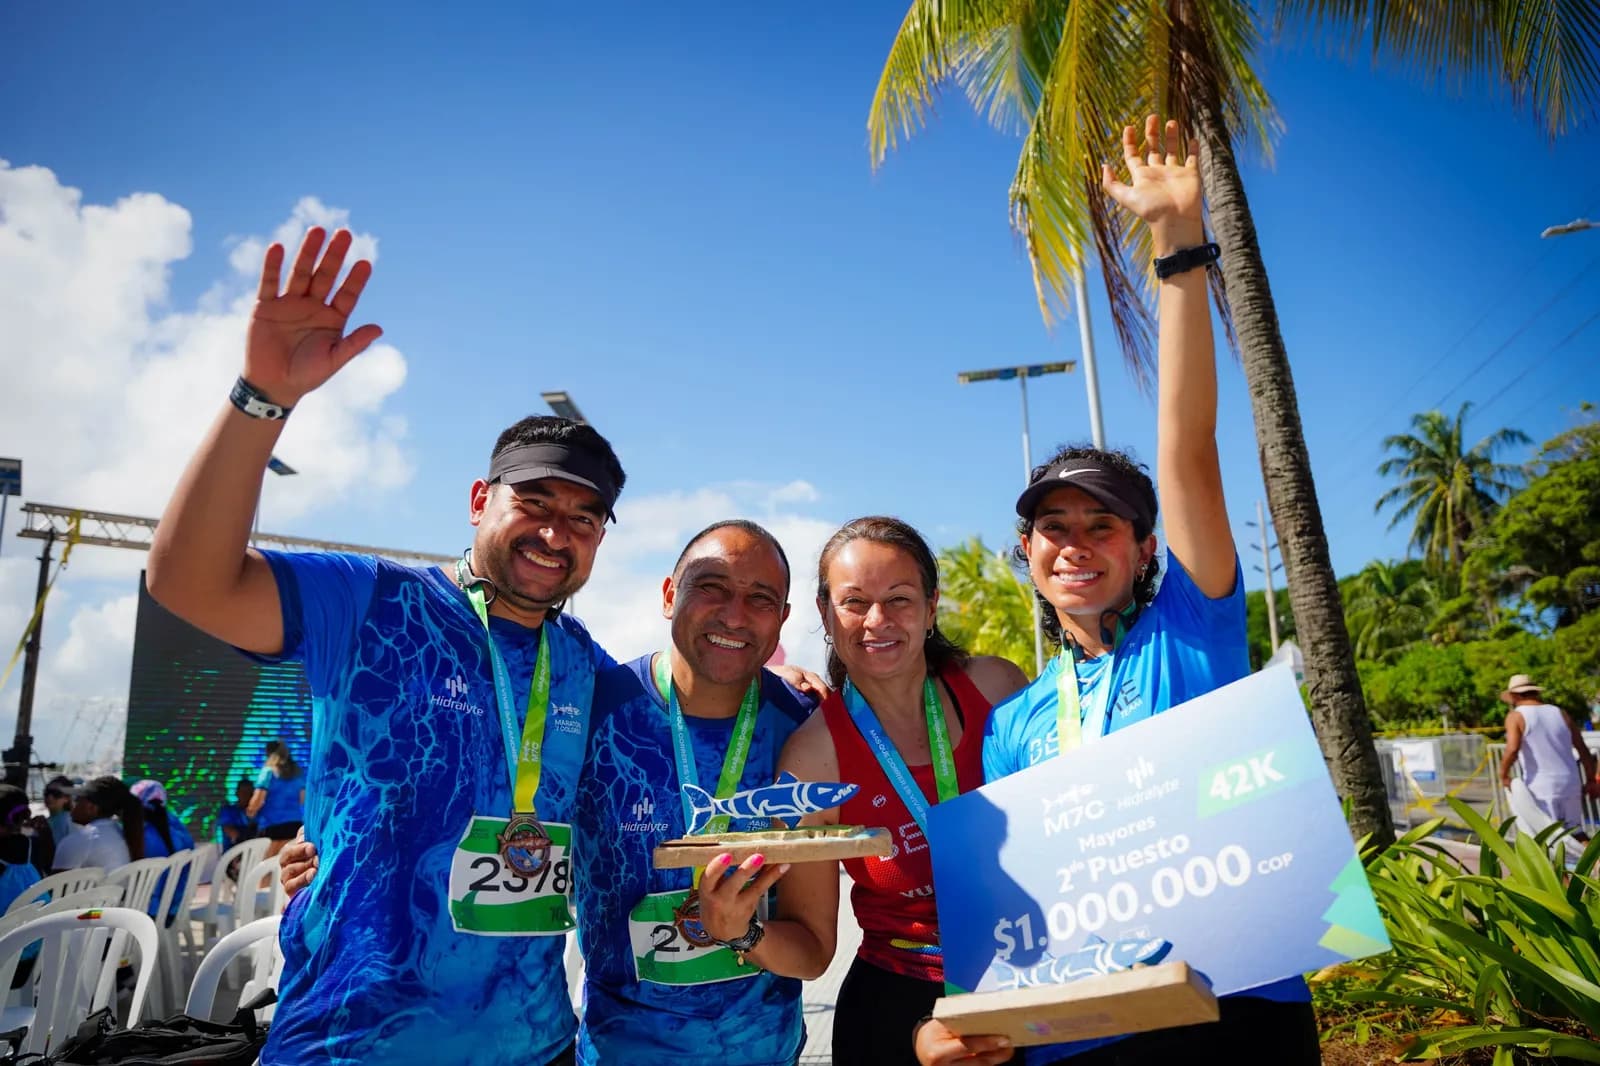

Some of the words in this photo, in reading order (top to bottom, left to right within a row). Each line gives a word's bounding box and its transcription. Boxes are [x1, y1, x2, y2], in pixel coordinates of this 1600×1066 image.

[430, 694, 484, 717] Hidralyte
[1209, 751, 1285, 801] 42K
[619, 821, 669, 833] Hidralyte
[1043, 800, 1105, 837] M7C
[1117, 778, 1180, 810] Hidralyte
[1078, 815, 1156, 853] Mayores
[1088, 833, 1190, 882] Puesto
[993, 844, 1251, 961] $1.000.000
[1257, 852, 1293, 875] COP
